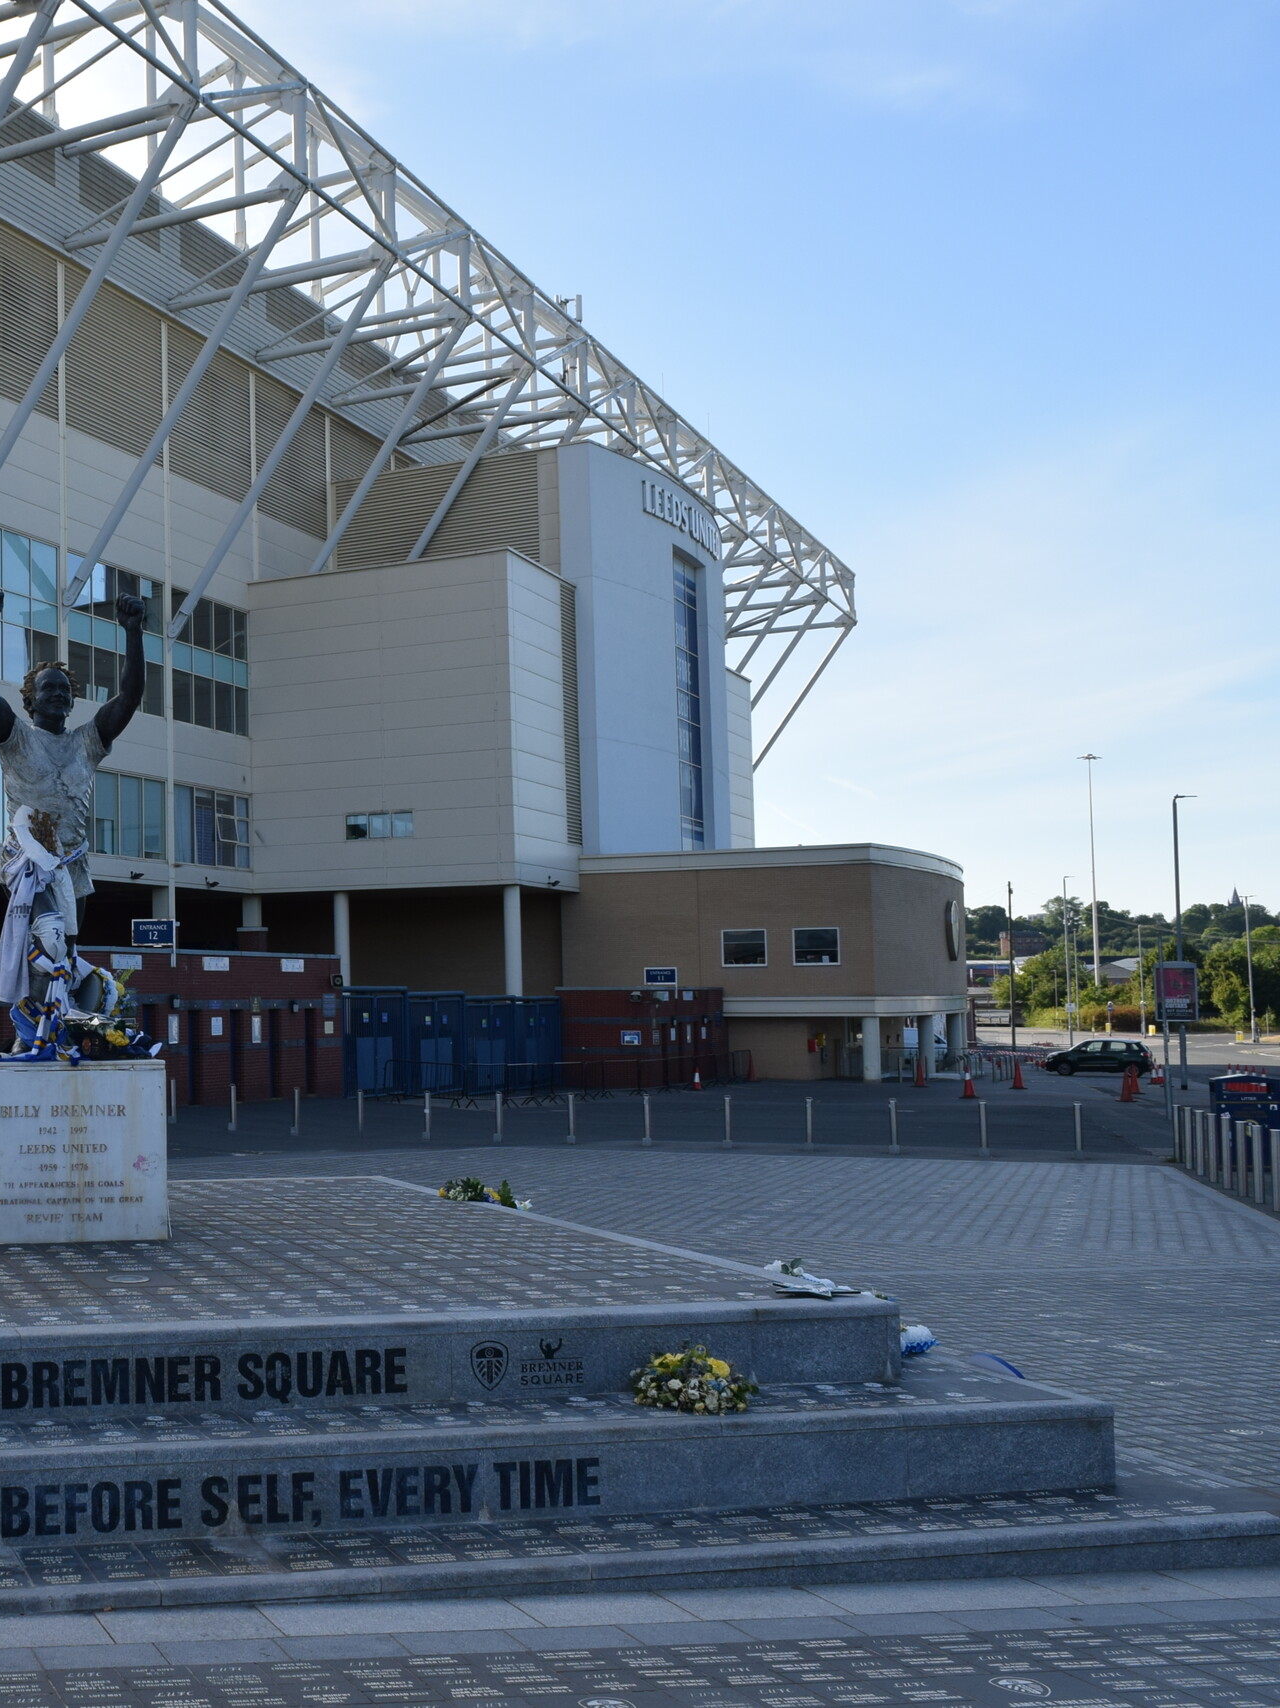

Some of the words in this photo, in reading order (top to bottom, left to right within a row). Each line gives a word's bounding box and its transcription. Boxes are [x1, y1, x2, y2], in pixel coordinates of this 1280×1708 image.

[641, 479, 689, 533] LEEDS
[139, 923, 168, 932] ENTRANCE
[148, 931, 159, 941] 12
[0, 1105, 41, 1119] BILLY
[50, 1104, 127, 1118] BREMNER
[38, 1126, 57, 1135] 1942
[69, 1126, 88, 1135] 1997
[19, 1144, 56, 1155] LEEDS
[62, 1143, 108, 1154] UNITED
[39, 1163, 58, 1172] 1959
[98, 1180, 125, 1188] GOALS
[46, 1196, 81, 1205] CAPTAIN
[85, 1196, 95, 1204] OF
[99, 1196, 115, 1204] THE
[119, 1195, 144, 1204] GREAT
[71, 1212, 103, 1224] TEAM
[520, 1360, 584, 1373] BREMNER
[1, 1356, 221, 1410] BREMNER
[237, 1347, 408, 1404] SQUARE
[520, 1373, 584, 1386] SQUARE
[0, 1478, 183, 1539] BEFORE
[201, 1471, 322, 1528] SELF,
[339, 1463, 479, 1520] EVERY
[493, 1457, 601, 1511] TIME
